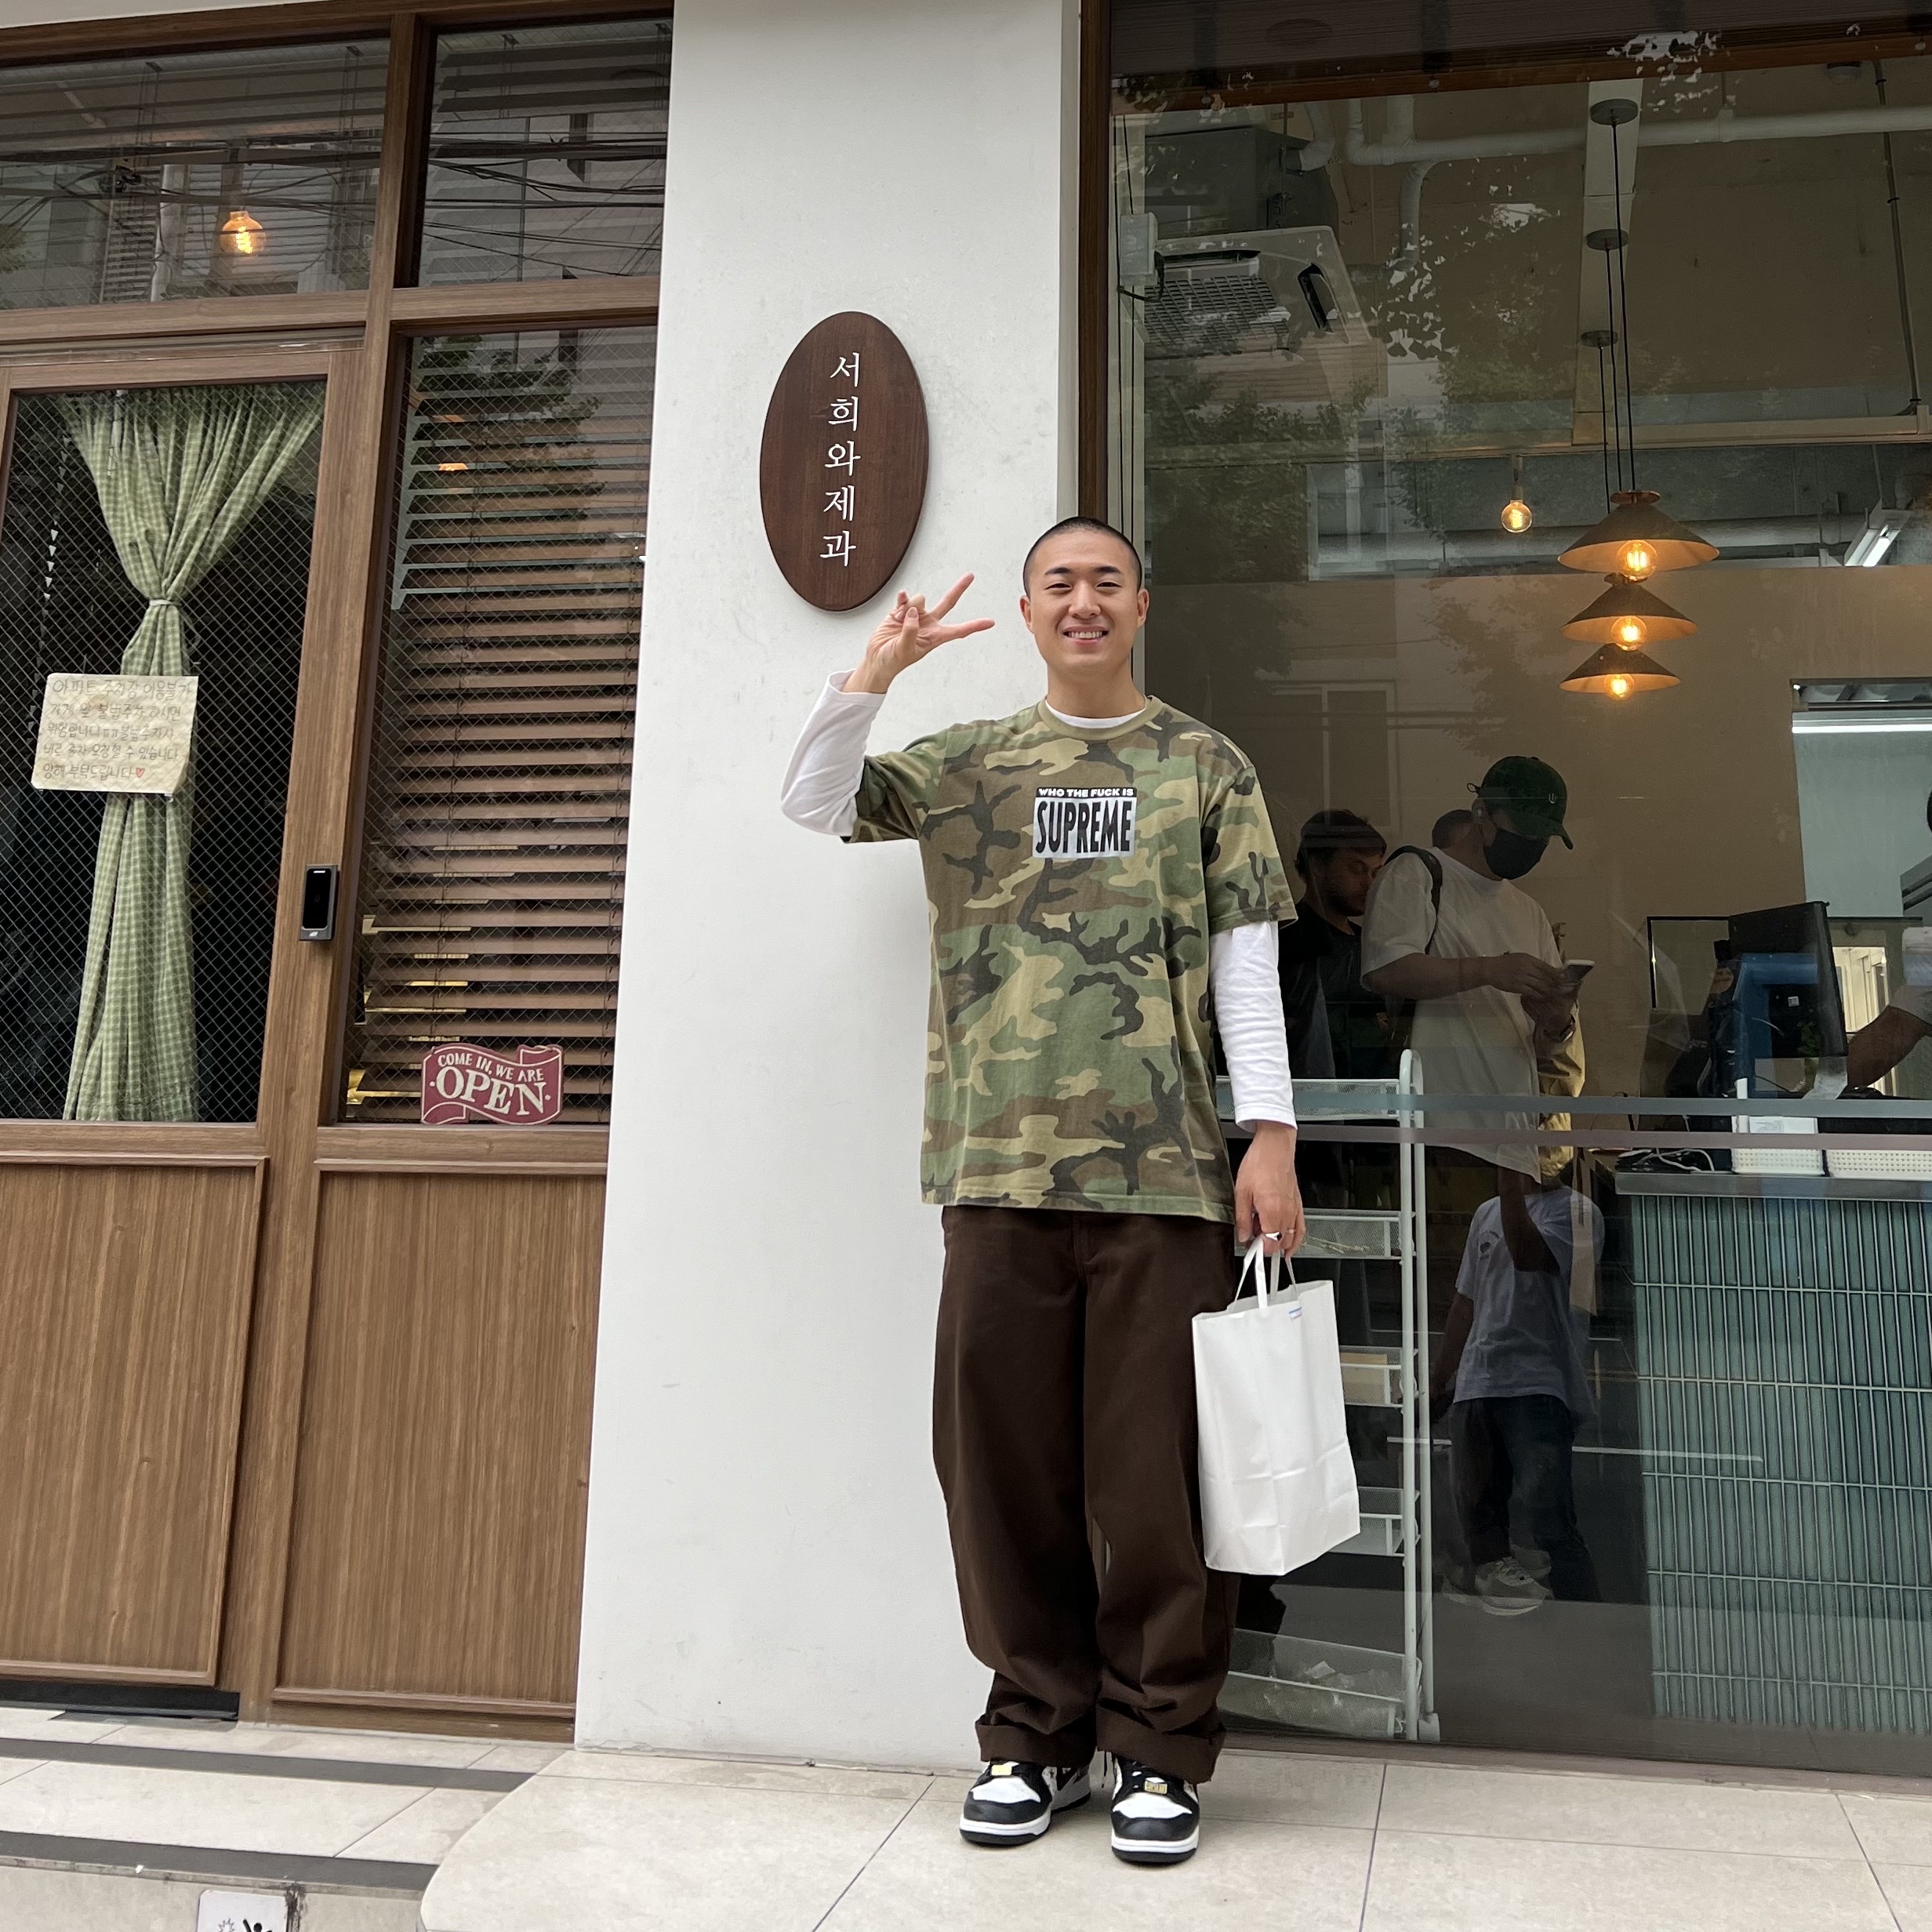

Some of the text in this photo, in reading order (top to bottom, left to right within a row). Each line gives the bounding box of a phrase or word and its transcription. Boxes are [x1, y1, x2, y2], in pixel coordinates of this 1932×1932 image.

[820, 352, 861, 567] 서희와제과
[53, 679, 192, 701] 아파트 주차장 이용불가
[99, 703, 145, 720] 불법주차
[150, 705, 181, 721] 하시면
[125, 746, 136, 760] 수
[138, 746, 178, 761] 있습니다
[42, 763, 133, 781] 양해 부탁드립니다
[1039, 788, 1134, 797] WHO THE FUCK IS
[1035, 799, 1133, 854] SUPREME
[438, 1052, 545, 1083] COME IN, WE ARE
[435, 1066, 547, 1116] OPEN
